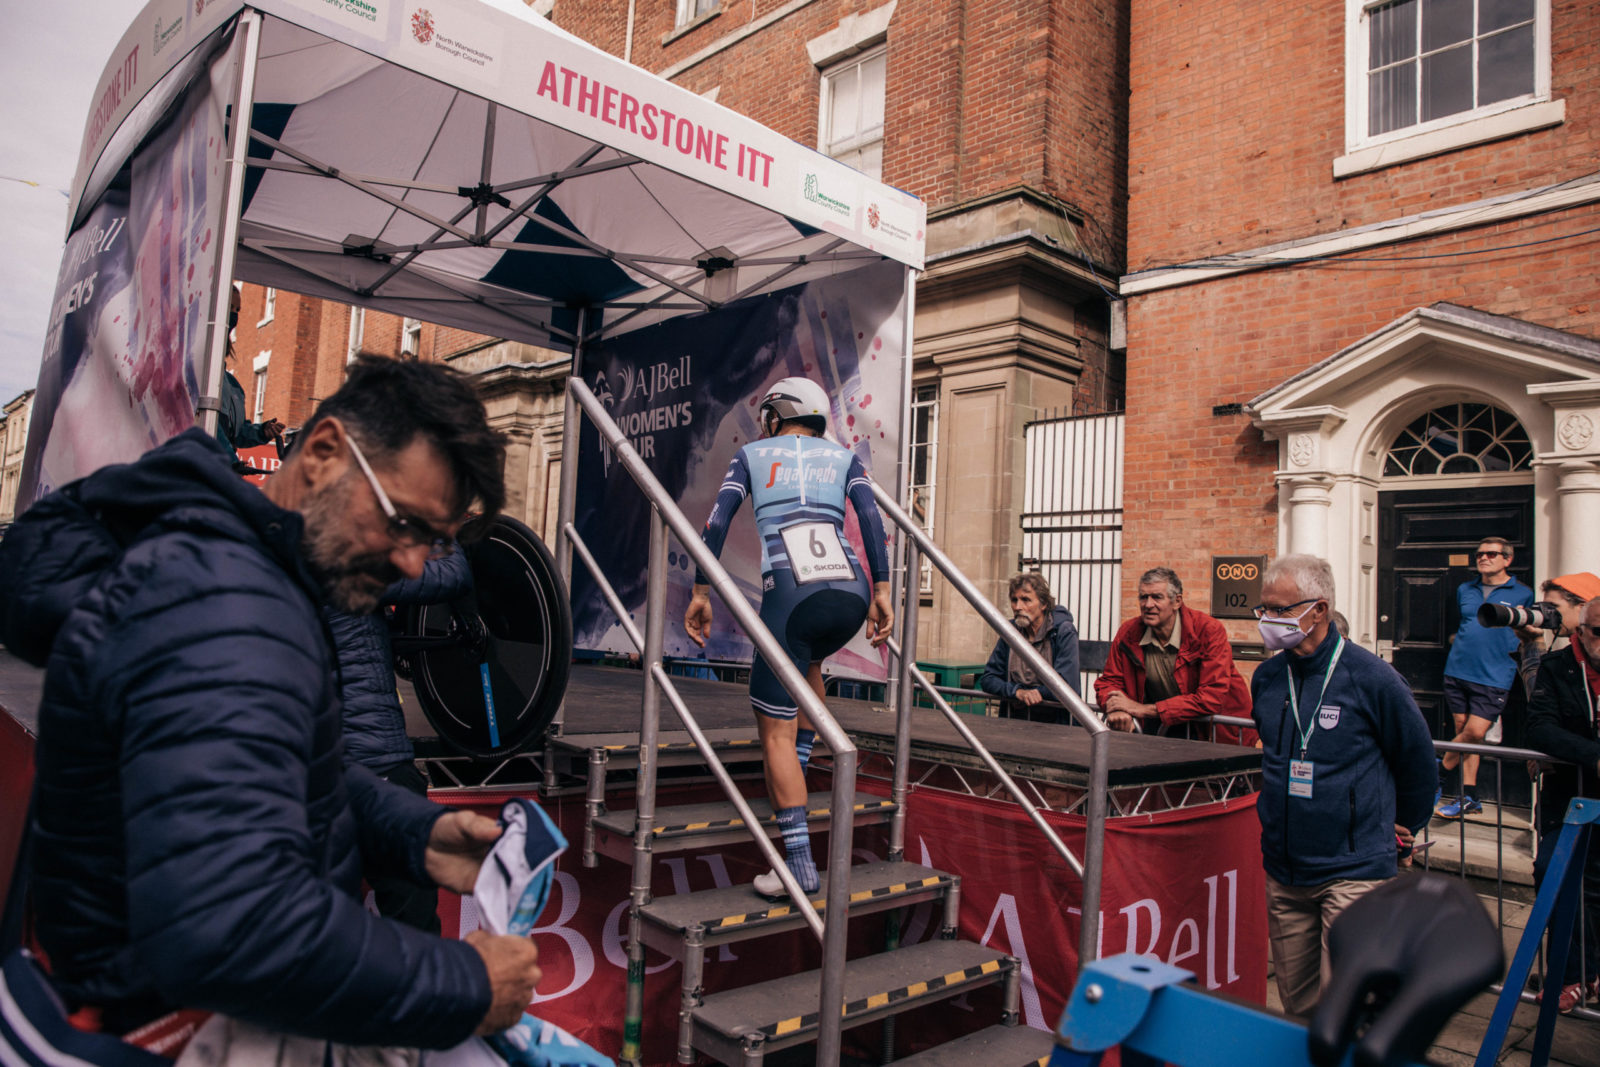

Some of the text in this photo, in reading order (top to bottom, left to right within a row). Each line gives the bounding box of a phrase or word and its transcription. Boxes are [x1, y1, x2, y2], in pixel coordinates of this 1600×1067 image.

[345, 3, 376, 22] Council
[435, 41, 484, 66] Borough Council
[436, 33, 493, 61] North Warwickshire
[536, 60, 774, 188] ATHERSTONE ITT
[616, 401, 693, 437] WOMEN'S
[755, 447, 846, 459] TREK
[765, 462, 837, 489] Segafredo
[808, 528, 827, 559] 6
[1218, 564, 1258, 579] TNT
[1224, 593, 1248, 607] 102
